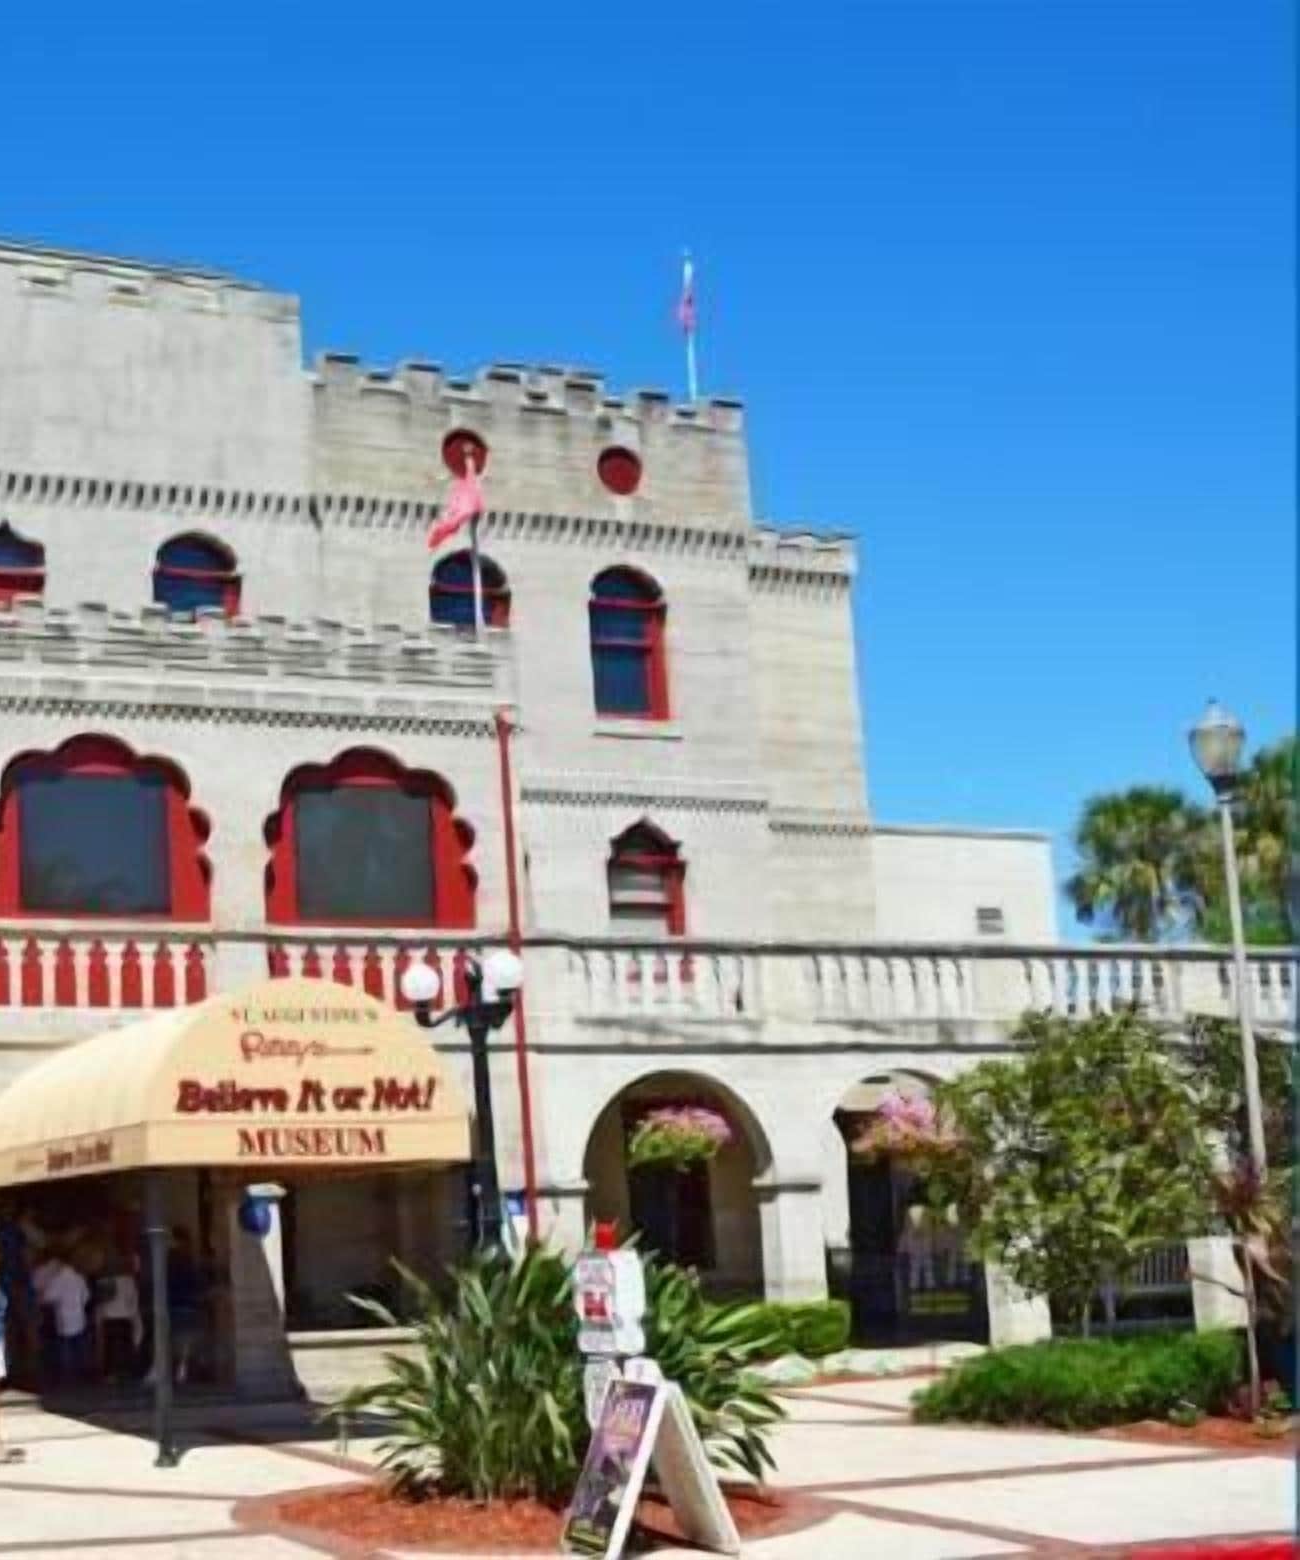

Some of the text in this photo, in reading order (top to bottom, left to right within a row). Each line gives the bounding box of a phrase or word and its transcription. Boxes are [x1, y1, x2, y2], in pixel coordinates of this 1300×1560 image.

[176, 1076, 436, 1113] Believe It or Not!
[237, 1127, 387, 1156] MUSEUM
